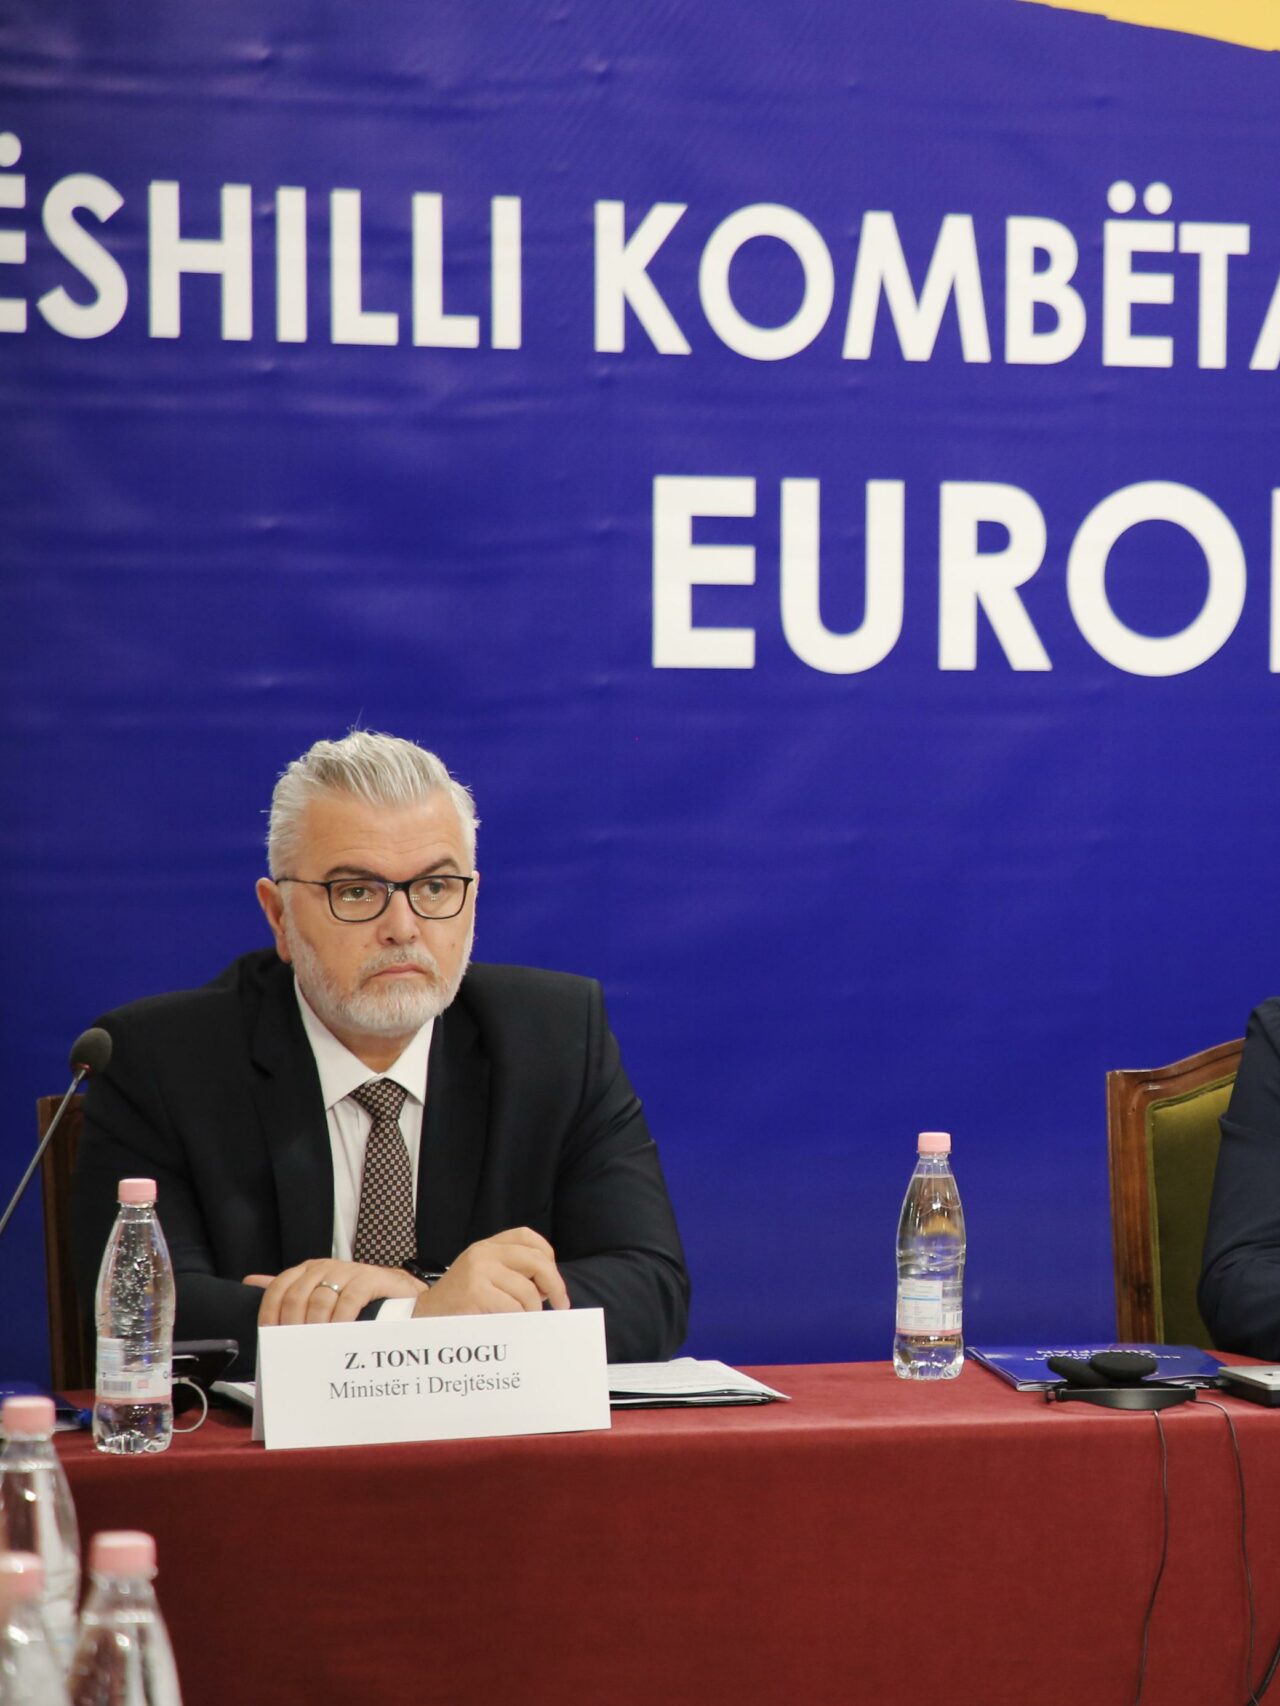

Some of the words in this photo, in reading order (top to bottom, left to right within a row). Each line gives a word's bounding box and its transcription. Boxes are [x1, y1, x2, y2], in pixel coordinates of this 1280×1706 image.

[345, 1352, 365, 1370] Z.
[372, 1348, 430, 1368] TONI
[437, 1344, 507, 1365] GOGU
[329, 1379, 409, 1400] Ministër
[416, 1377, 421, 1394] i
[428, 1372, 521, 1397] Drejtësisë
